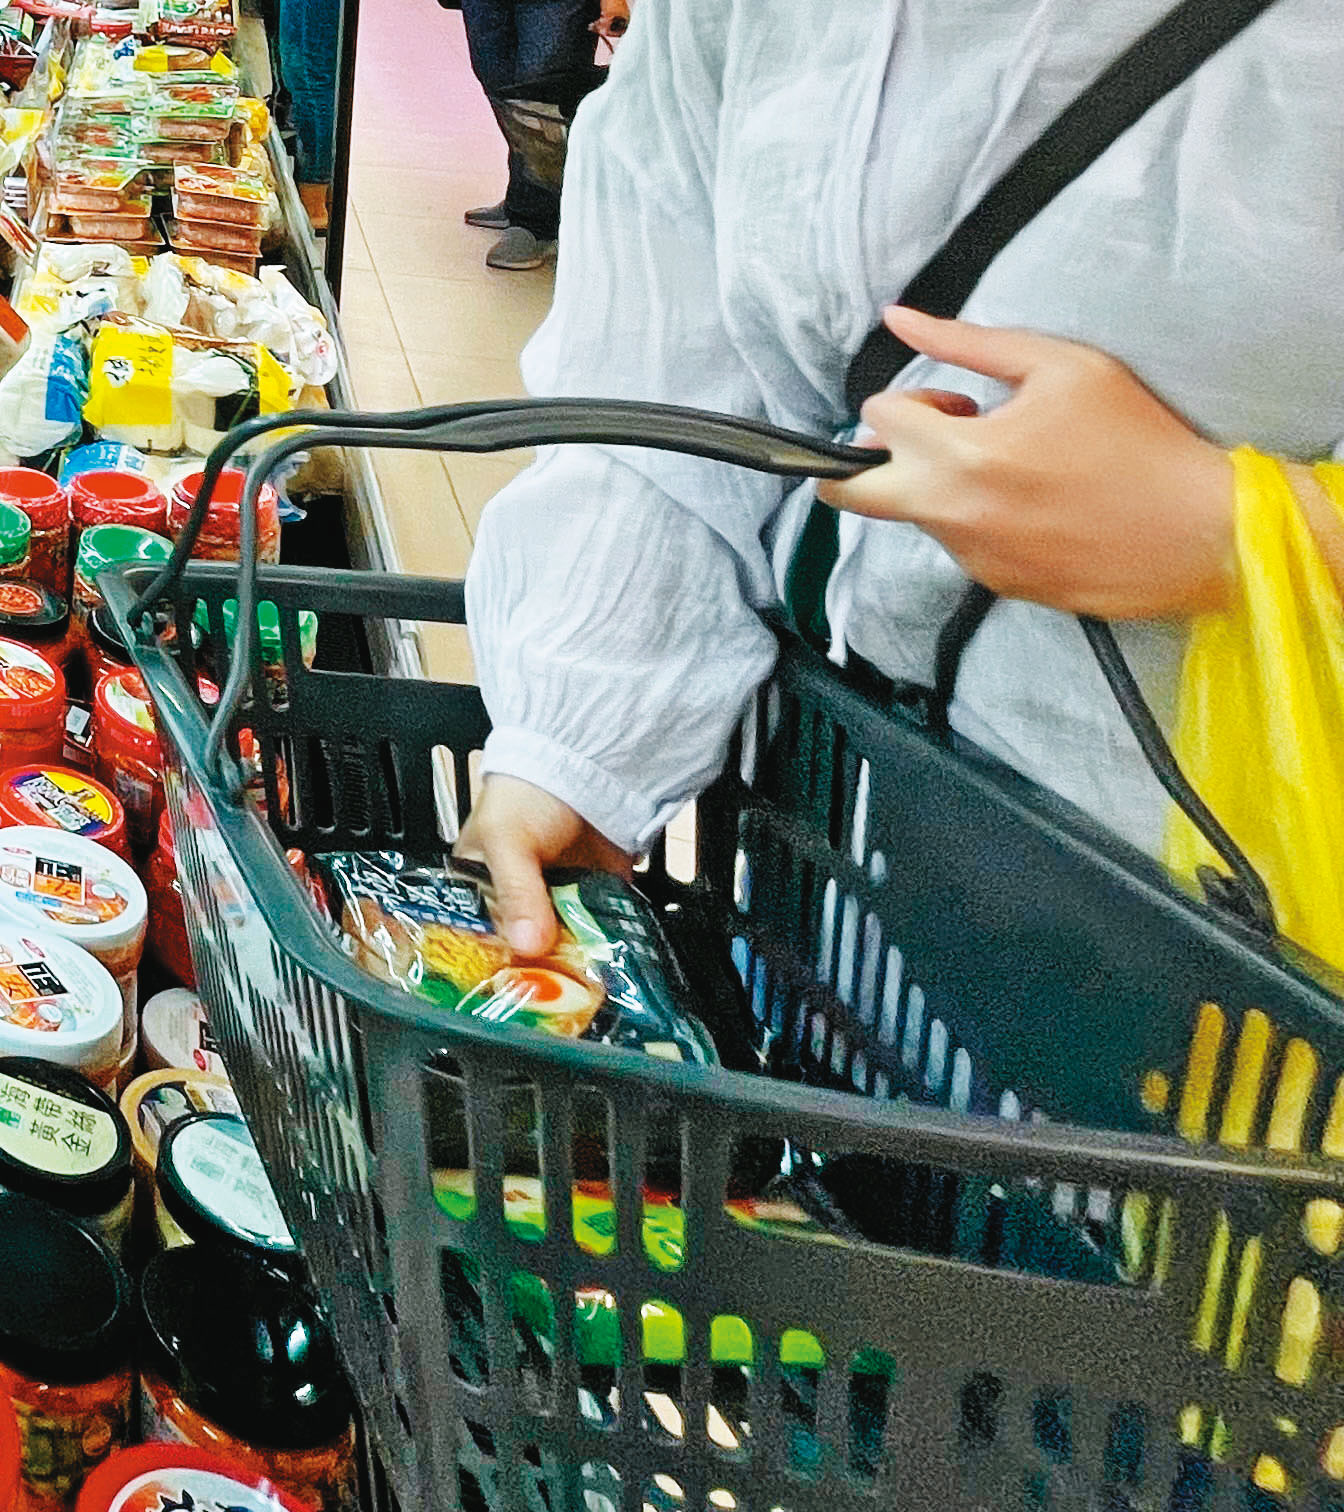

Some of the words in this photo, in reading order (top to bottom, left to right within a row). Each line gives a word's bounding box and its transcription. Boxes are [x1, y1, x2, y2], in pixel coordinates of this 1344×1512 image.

[1, 1082, 96, 1134] 海帶絲
[29, 1119, 91, 1156] 黃金
